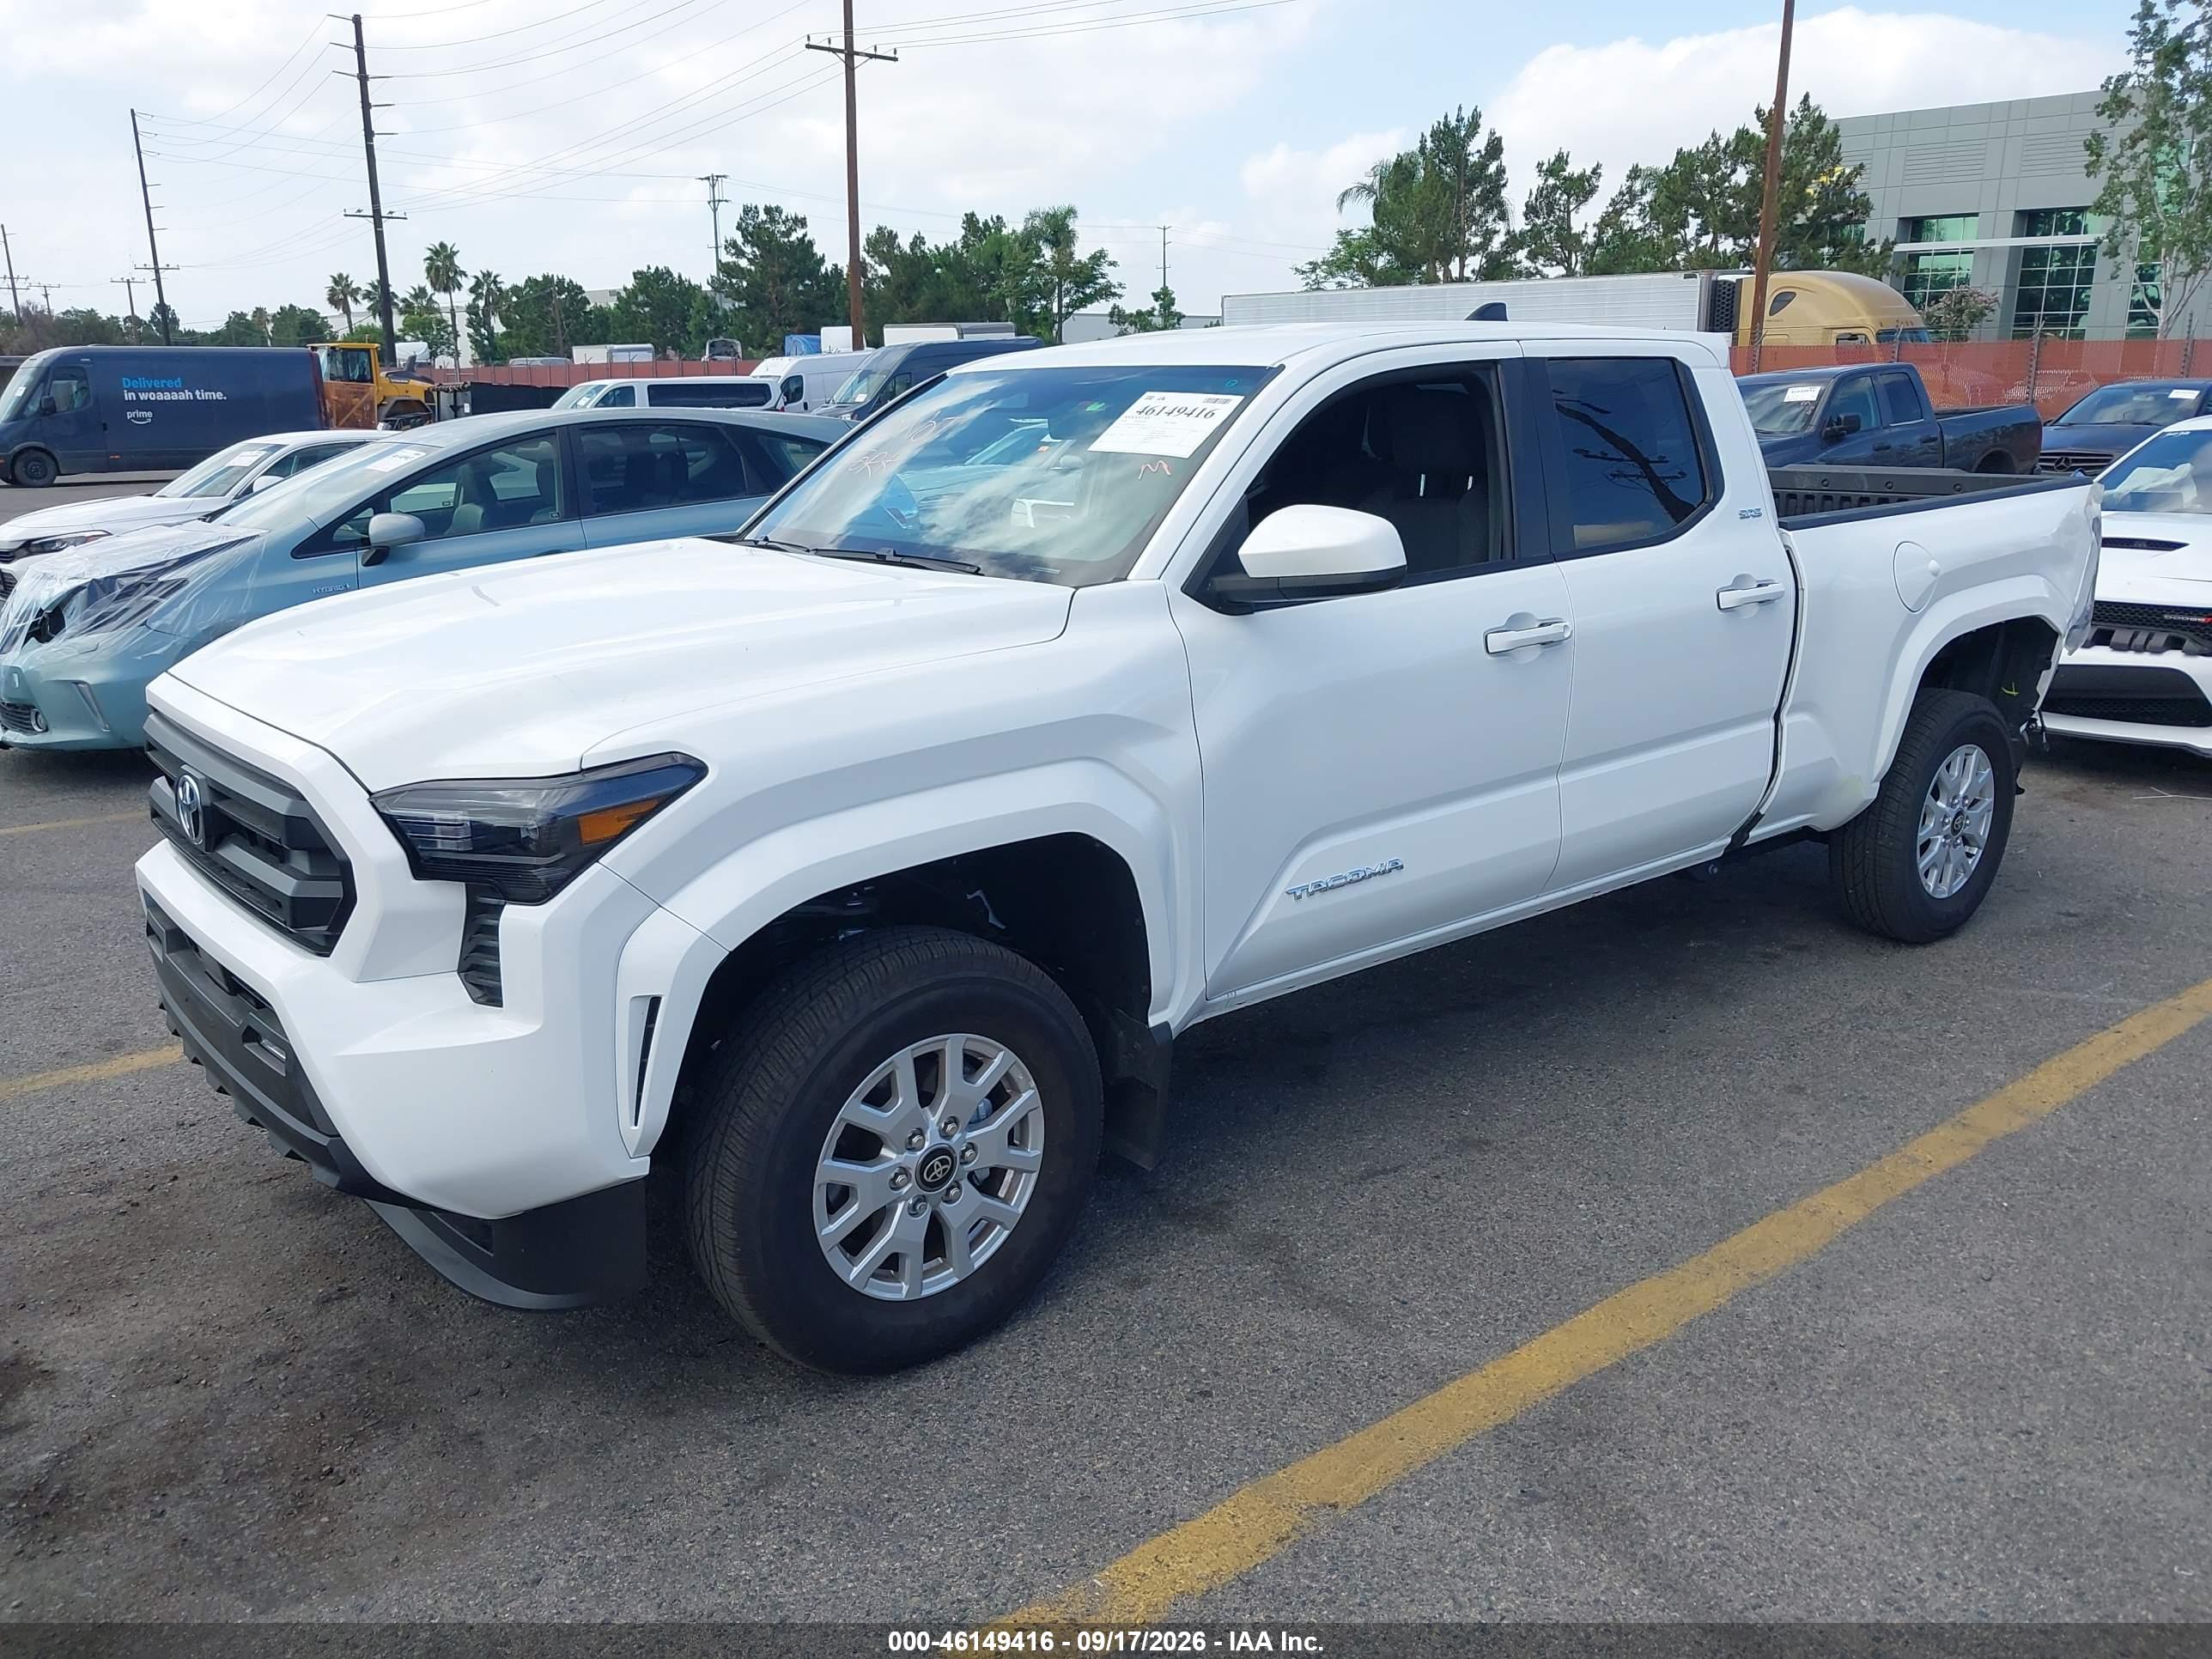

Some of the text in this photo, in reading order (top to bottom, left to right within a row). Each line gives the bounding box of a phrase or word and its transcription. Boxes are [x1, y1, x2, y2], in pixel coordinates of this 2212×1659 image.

[122, 378, 182, 389] Delivered
[124, 390, 227, 401] in woaaaah time.
[126, 410, 153, 420] prime
[1136, 405, 1218, 419] 46149416
[313, 585, 344, 593] HYBRID
[1285, 857, 1404, 901] TACOMA
